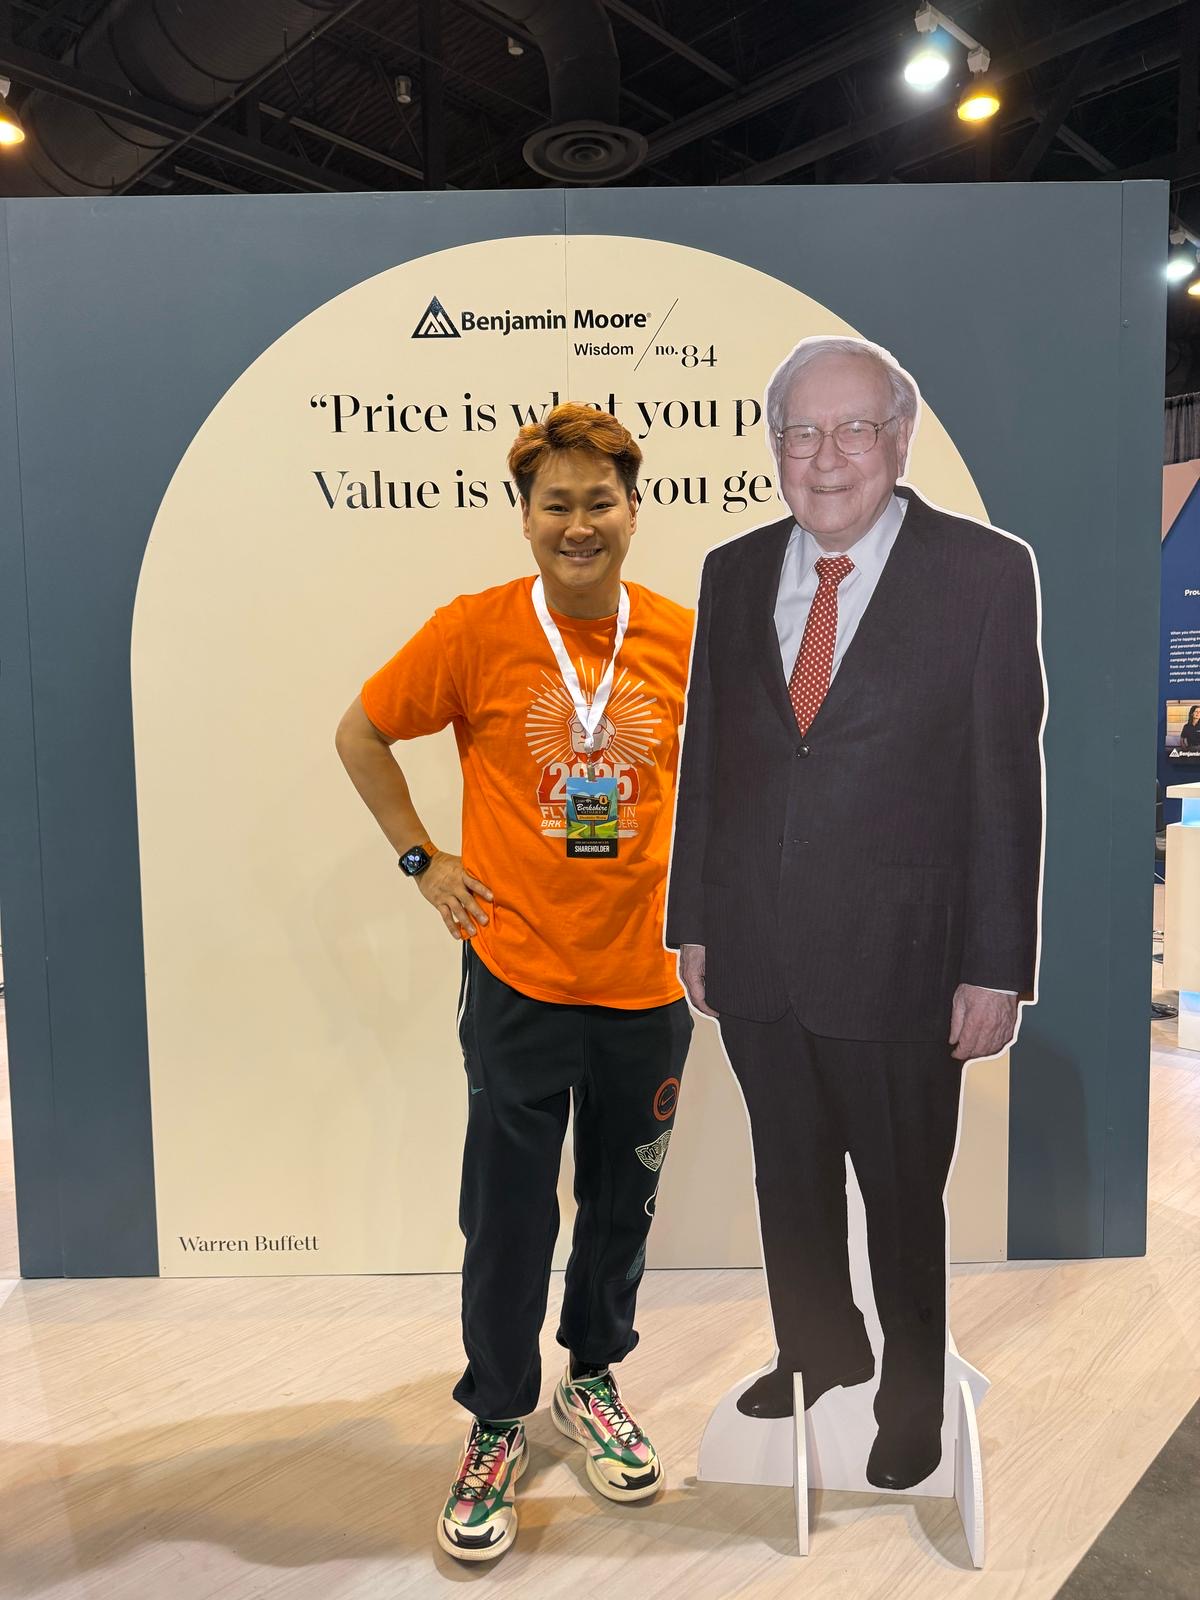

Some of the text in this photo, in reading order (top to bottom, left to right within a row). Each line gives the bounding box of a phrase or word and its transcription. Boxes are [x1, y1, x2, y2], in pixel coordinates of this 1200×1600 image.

[461, 309, 566, 335] Benjamin
[573, 342, 634, 356] Wisdom
[655, 345, 718, 367] no. 84
[462, 393, 496, 431] is
[636, 400, 719, 439] you
[313, 470, 440, 509] Value
[454, 470, 488, 508] is
[722, 471, 782, 513] ge
[541, 819, 562, 828] BRK
[575, 845, 610, 853] SHAREHOLDER
[178, 1235, 320, 1251] Warren Buffett
